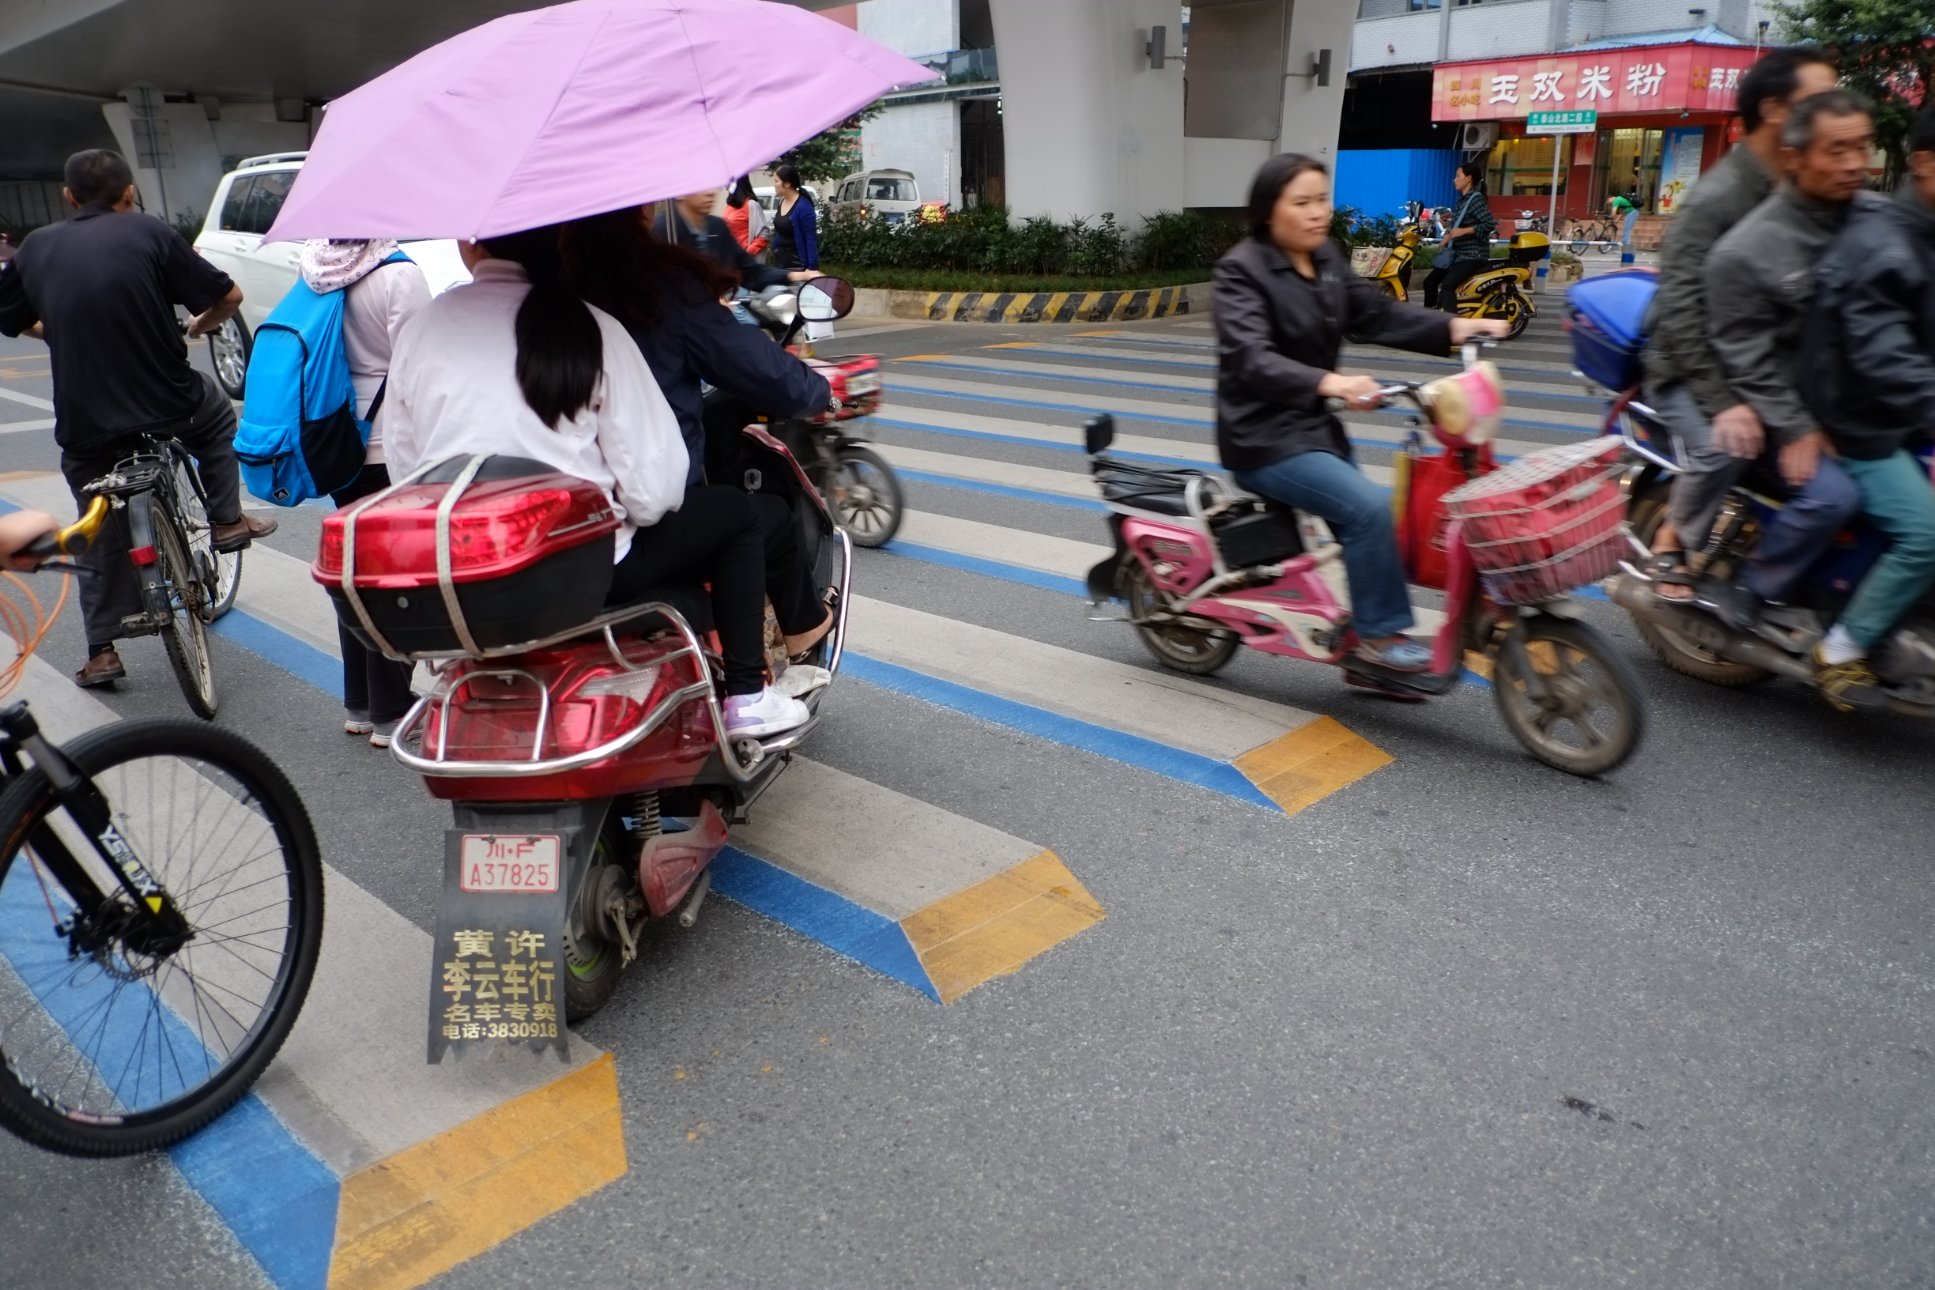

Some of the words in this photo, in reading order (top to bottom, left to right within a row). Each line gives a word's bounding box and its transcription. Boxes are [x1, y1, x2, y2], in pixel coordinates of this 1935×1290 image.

[1488, 62, 1667, 104] 玉双米粉
[1709, 67, 1747, 90] 玉双
[470, 863, 550, 887] A37825
[452, 929, 546, 958] 黄许
[442, 958, 556, 1002] 李云车行
[442, 1002, 557, 1023] 名车专卖
